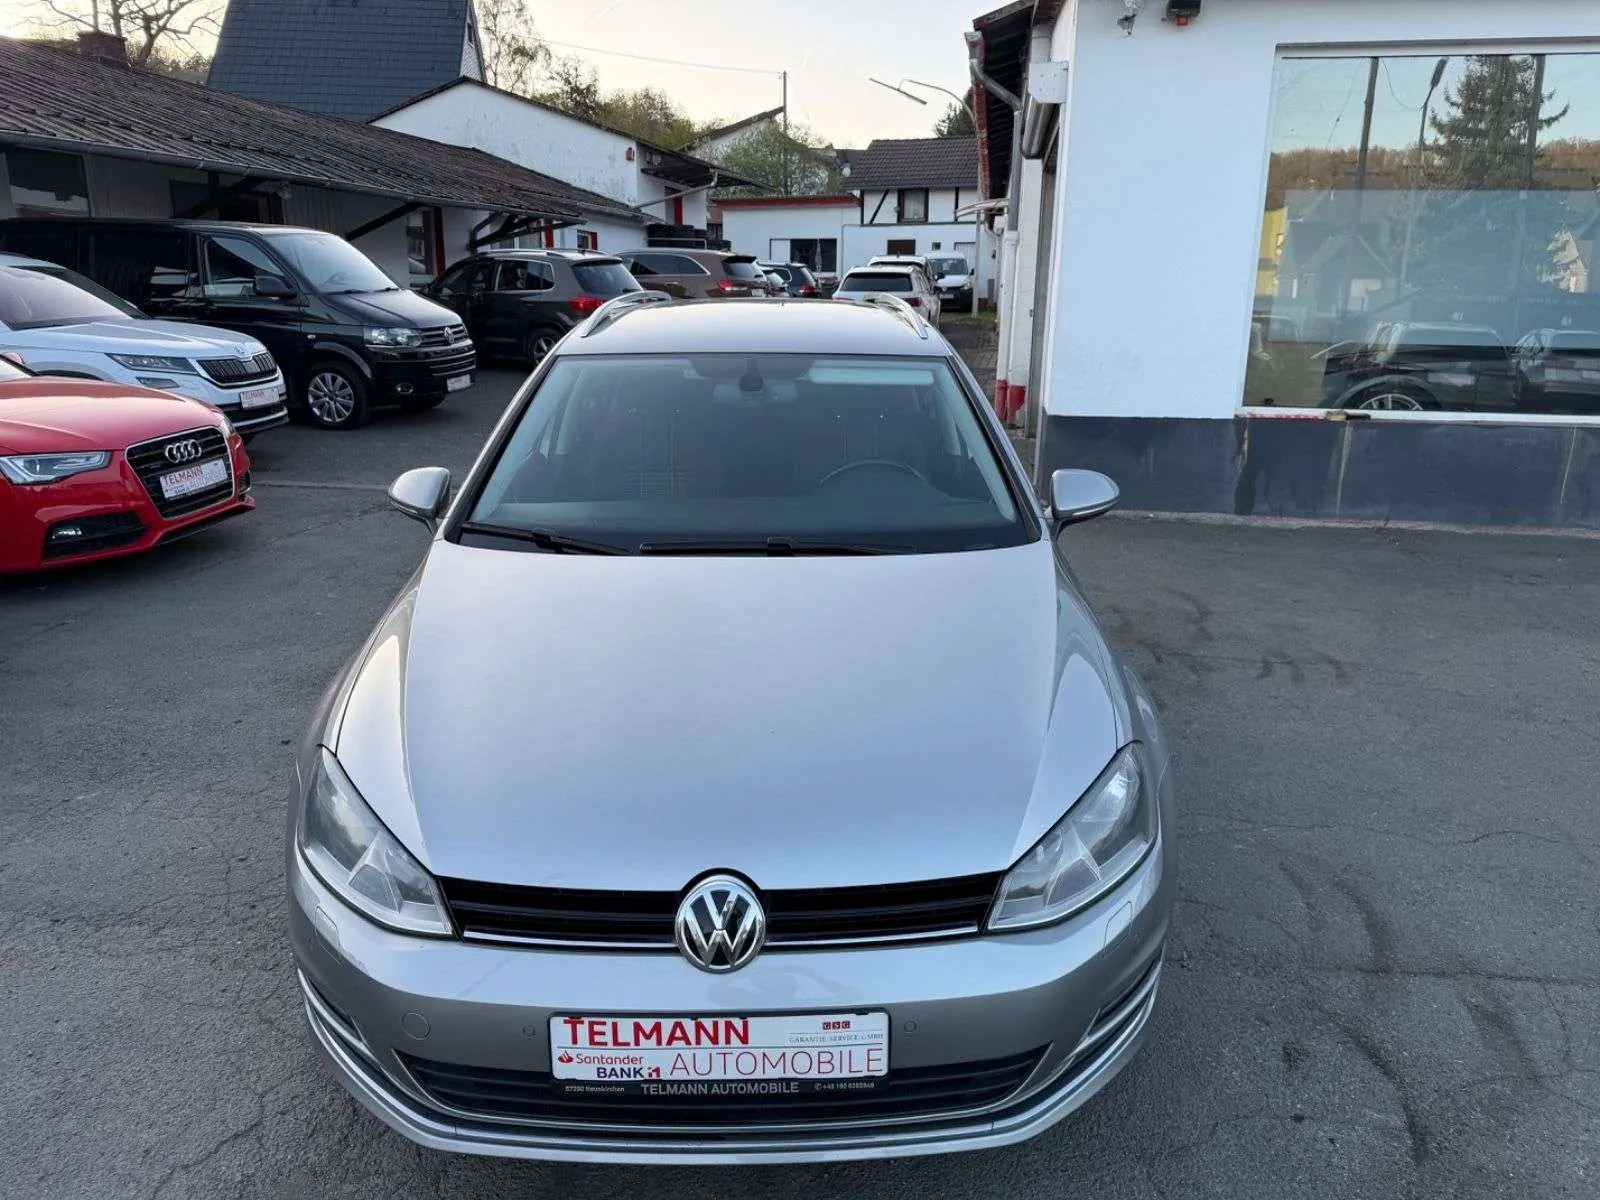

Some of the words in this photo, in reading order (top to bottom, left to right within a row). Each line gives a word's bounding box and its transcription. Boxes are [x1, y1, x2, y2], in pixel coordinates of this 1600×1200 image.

[164, 465, 204, 486] TELMANN
[563, 1018, 749, 1047] TELMANN
[576, 1053, 643, 1065] Santander
[669, 1048, 883, 1076] AUTOMOBILE
[596, 1067, 644, 1079] BANK
[641, 1083, 708, 1095] TELMANN
[711, 1082, 800, 1094] AUTOMOBILE
